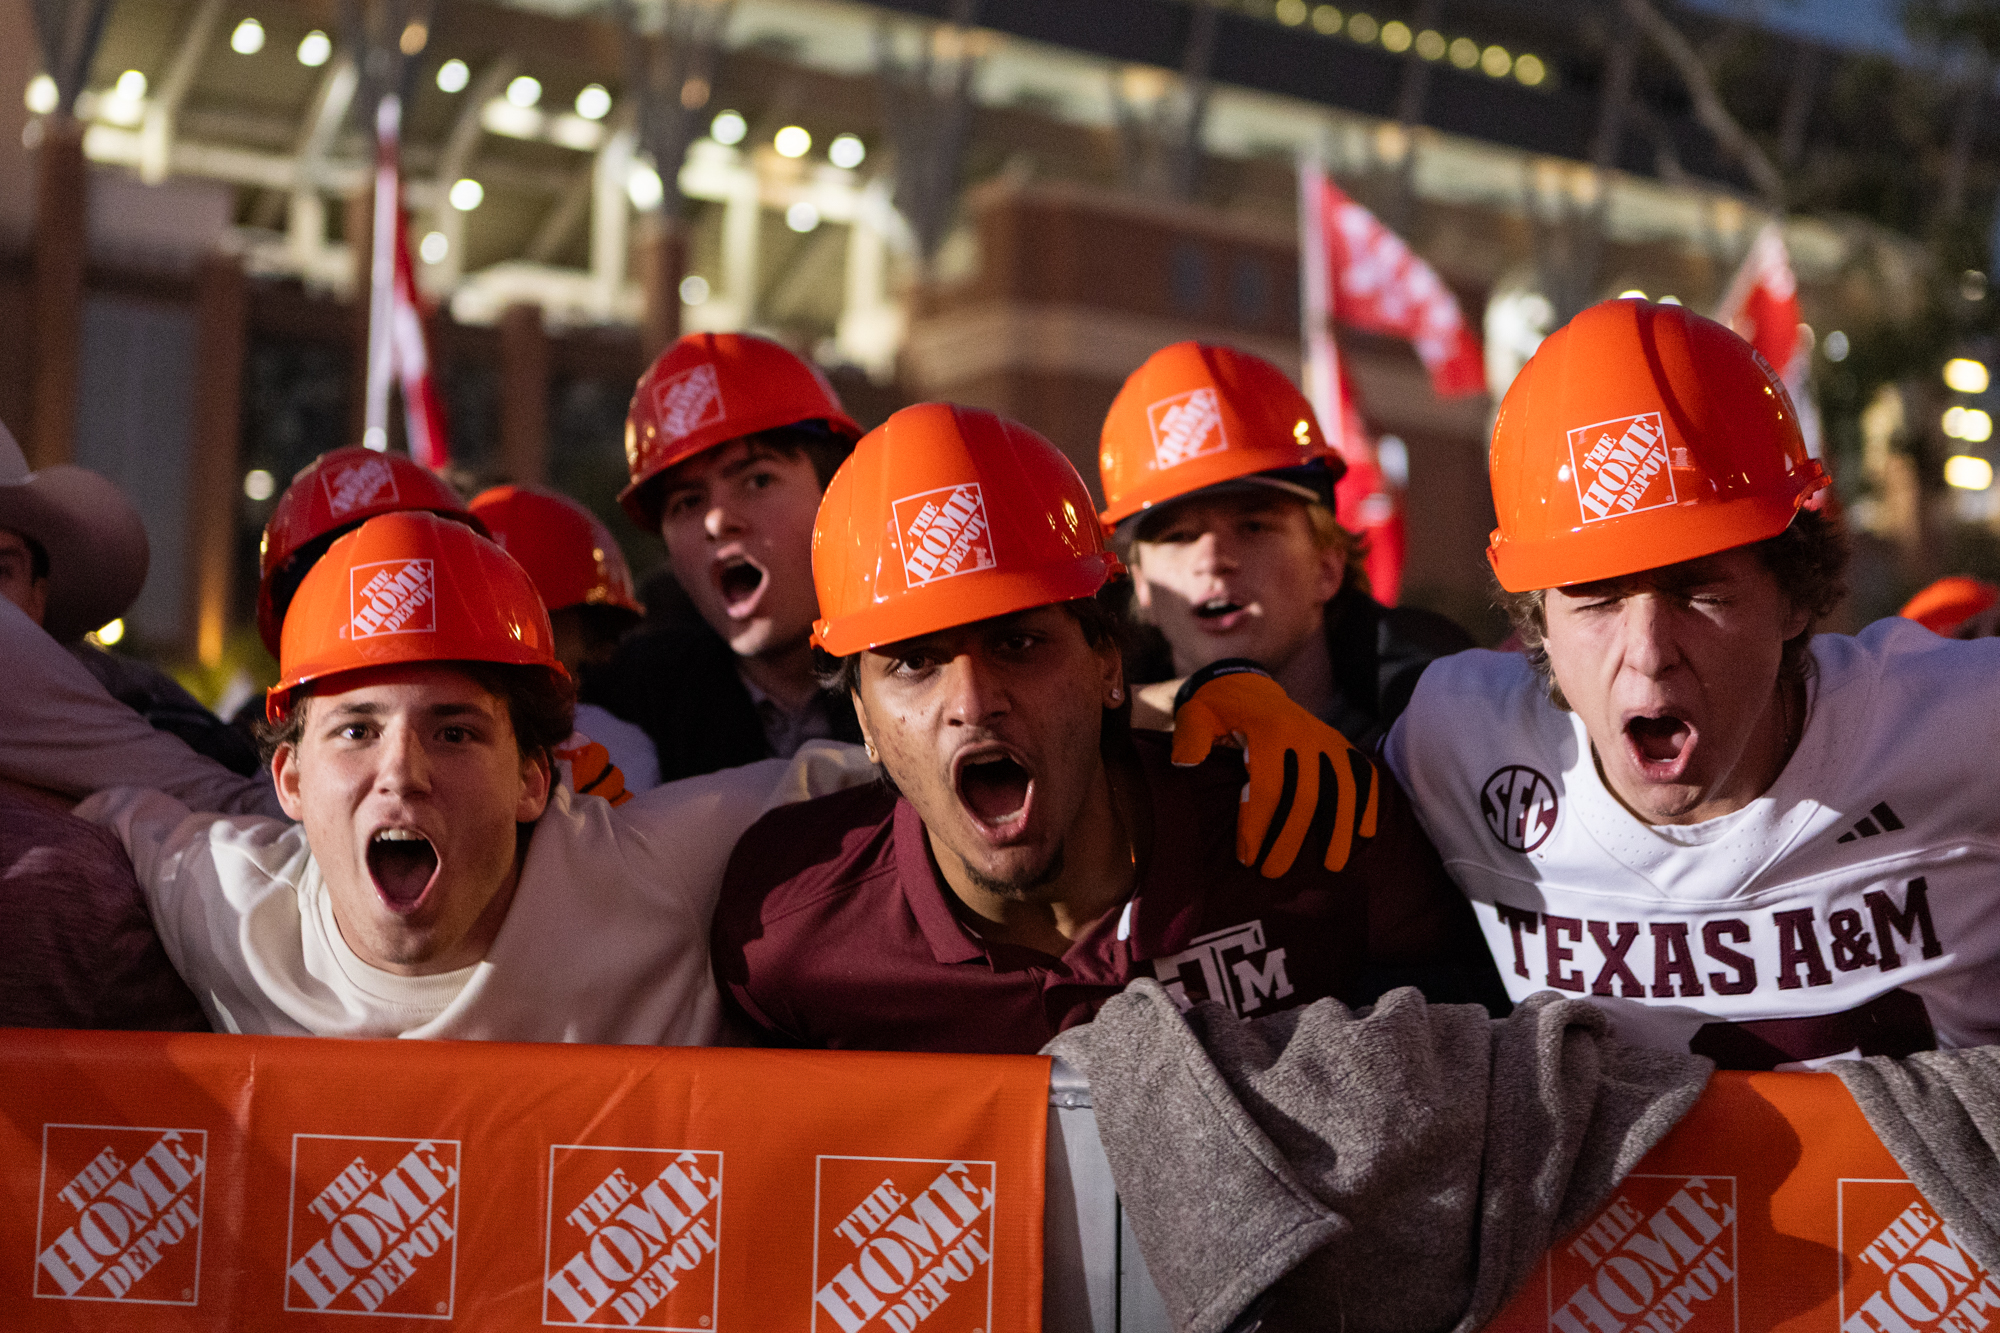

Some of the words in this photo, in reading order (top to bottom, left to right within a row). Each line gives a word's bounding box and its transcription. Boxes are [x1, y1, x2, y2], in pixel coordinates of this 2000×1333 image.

[1581, 415, 1662, 518] HOME
[1582, 433, 1617, 472] THE
[1616, 446, 1667, 512] DEPOT
[906, 485, 981, 581] HOME
[907, 501, 940, 538] THE
[940, 513, 986, 575] DEPOT
[354, 560, 432, 636] HOME
[359, 569, 392, 599] THE
[383, 584, 432, 632] DEPOT
[1482, 766, 1557, 852] SEC
[1498, 900, 1757, 998] TEXAS
[1772, 876, 1942, 990] A&M
[38, 1130, 204, 1297] HOME
[57, 1145, 127, 1213] THE
[307, 1156, 378, 1225] THE
[565, 1167, 639, 1237] THE
[833, 1178, 908, 1248] THE
[100, 1194, 200, 1300] DEPOT
[288, 1140, 458, 1312] HOME
[350, 1206, 456, 1313] DEPOT
[545, 1151, 720, 1325] HOME
[815, 1161, 993, 1333] HOME
[1552, 1177, 1737, 1333] HOME
[1567, 1195, 1646, 1268] THE
[1858, 1201, 1938, 1274] THE
[610, 1217, 718, 1328] DEPOT
[881, 1229, 990, 1333] DEPOT
[1630, 1246, 1734, 1333] EPOT
[1842, 1224, 1986, 1333] HOM
